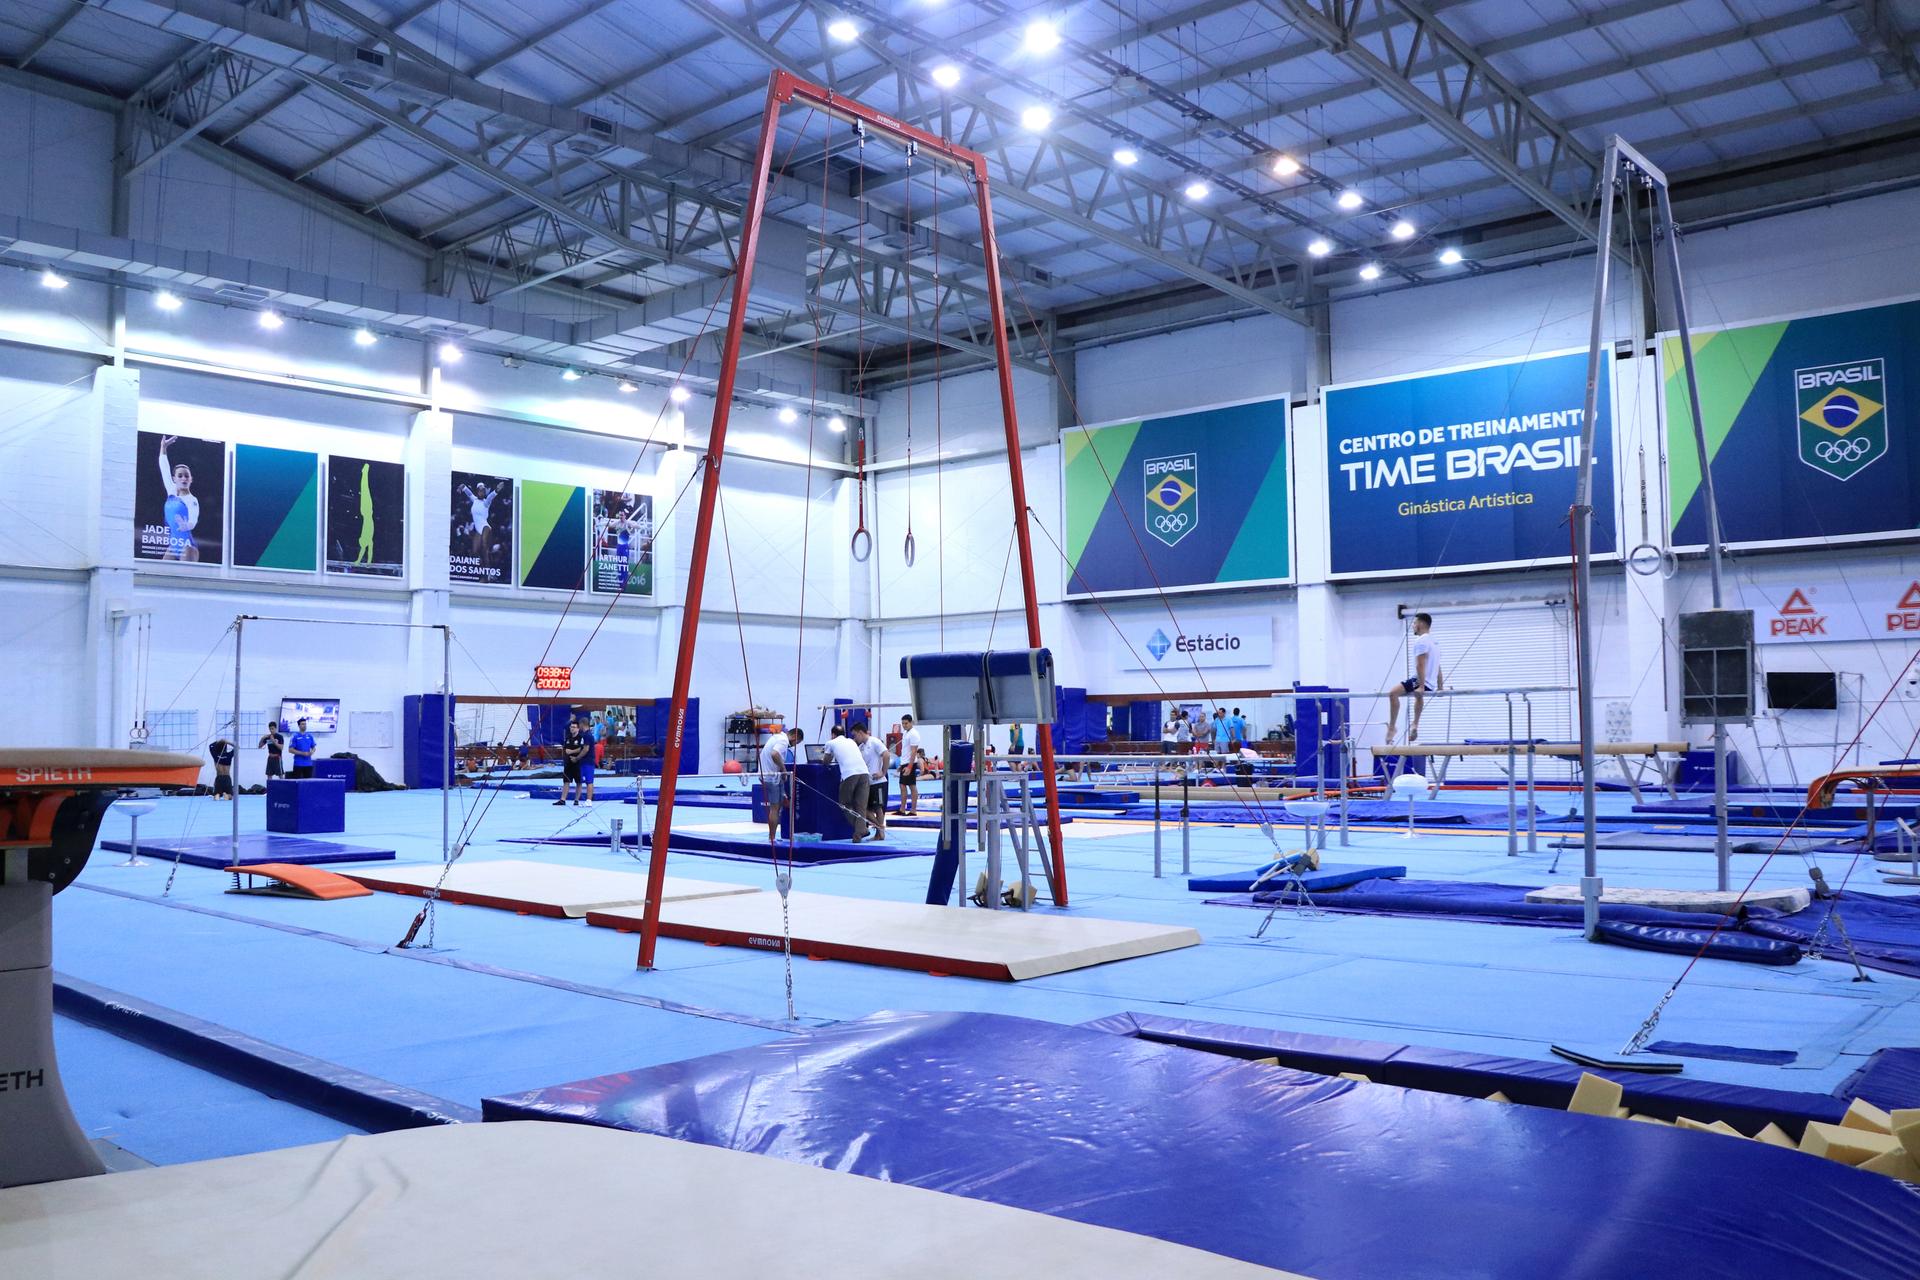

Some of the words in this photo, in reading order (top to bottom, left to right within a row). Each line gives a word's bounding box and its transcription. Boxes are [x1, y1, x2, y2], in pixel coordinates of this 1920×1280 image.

[1799, 365, 1881, 390] BRASIL
[1339, 430, 1416, 455] CENTRO
[1419, 426, 1446, 445] DE
[1146, 458, 1195, 475] BRASIL
[1340, 453, 1436, 491] TIME
[1446, 435, 1598, 480] BRASIL
[1398, 496, 1465, 516] Ginástica
[1469, 490, 1534, 509] Artística
[142, 524, 171, 535] JADE
[142, 535, 192, 547] BARBOSA
[449, 555, 480, 566] DAIANE
[598, 554, 628, 563] ARTHUR
[449, 564, 467, 574] DOS
[468, 566, 501, 577] SANTOS
[598, 562, 629, 572] ZANETTI
[1770, 616, 1828, 636] PEAK
[1886, 612, 1920, 631] PE
[1175, 632, 1241, 652] Estácio
[16, 767, 93, 782] SPIETH
[748, 936, 780, 947] GYMNOVA
